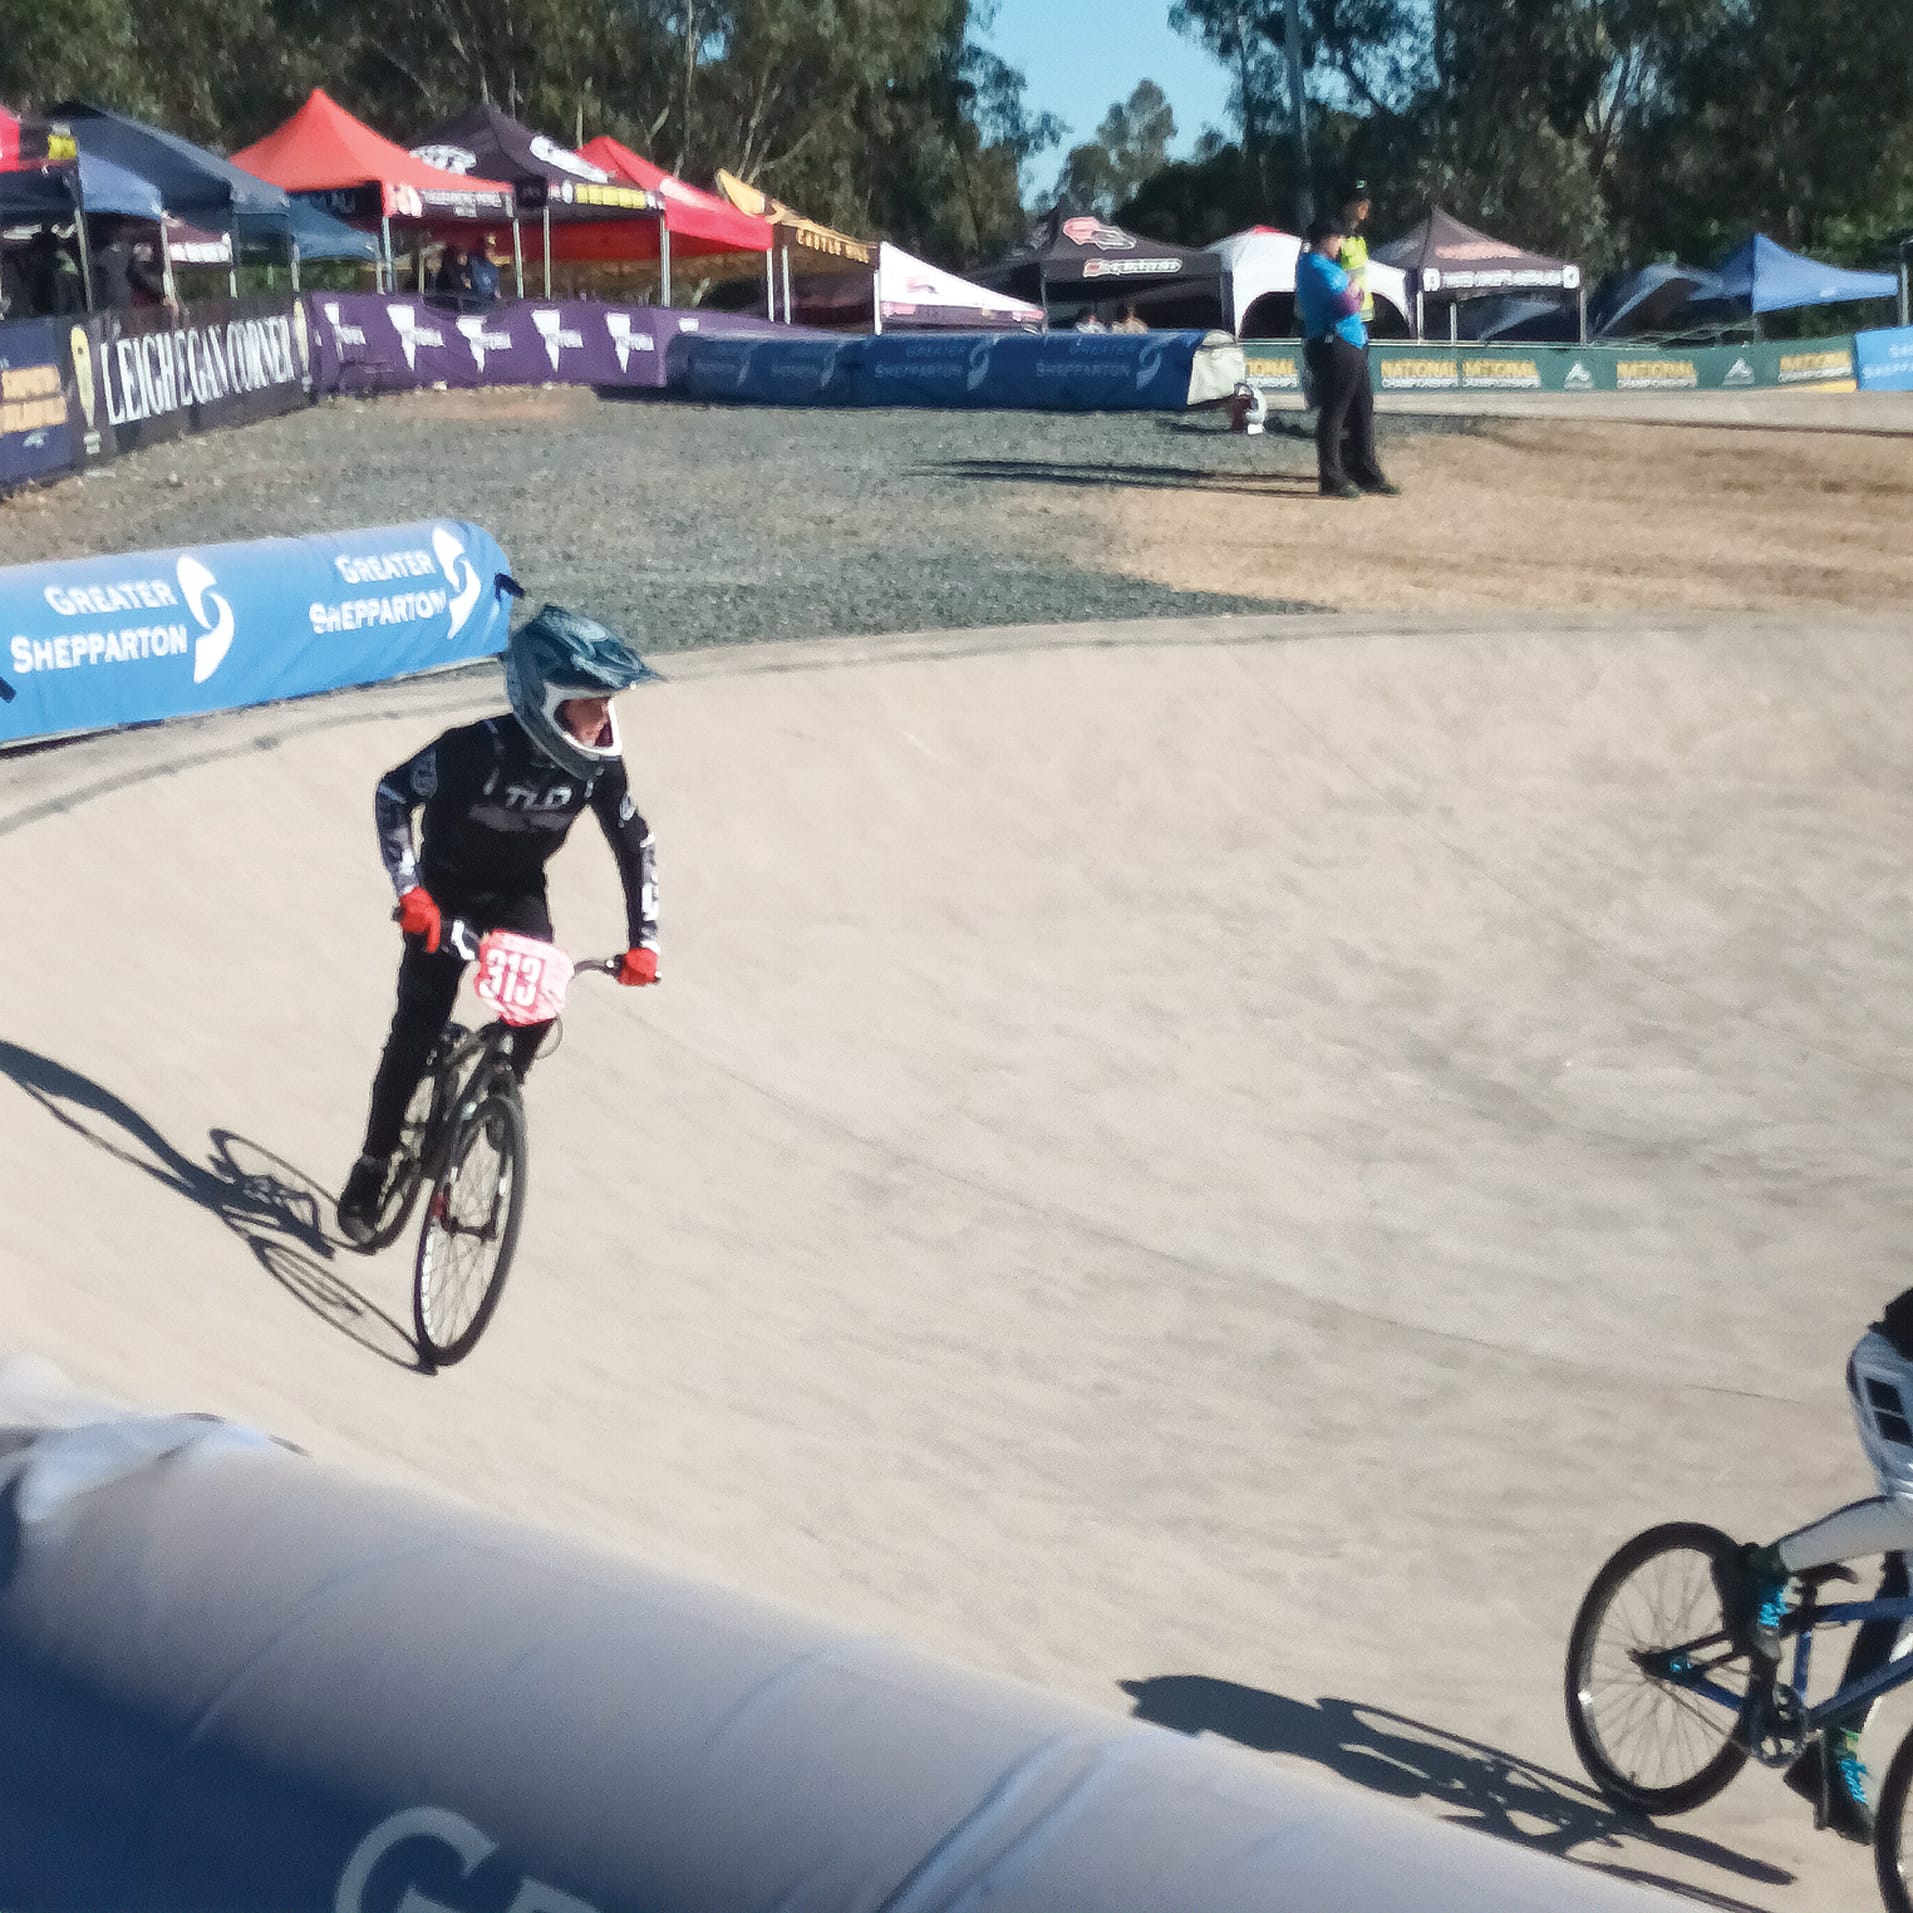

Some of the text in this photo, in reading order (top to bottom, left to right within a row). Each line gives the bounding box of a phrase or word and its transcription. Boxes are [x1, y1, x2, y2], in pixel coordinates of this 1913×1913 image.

[101, 332, 178, 426] LEIGH
[335, 549, 437, 584] GREATER
[43, 579, 179, 616] GREATER
[308, 588, 447, 635] SHEPPARTON
[9, 623, 188, 675] SHEPPARTON
[477, 948, 544, 1007] 313
